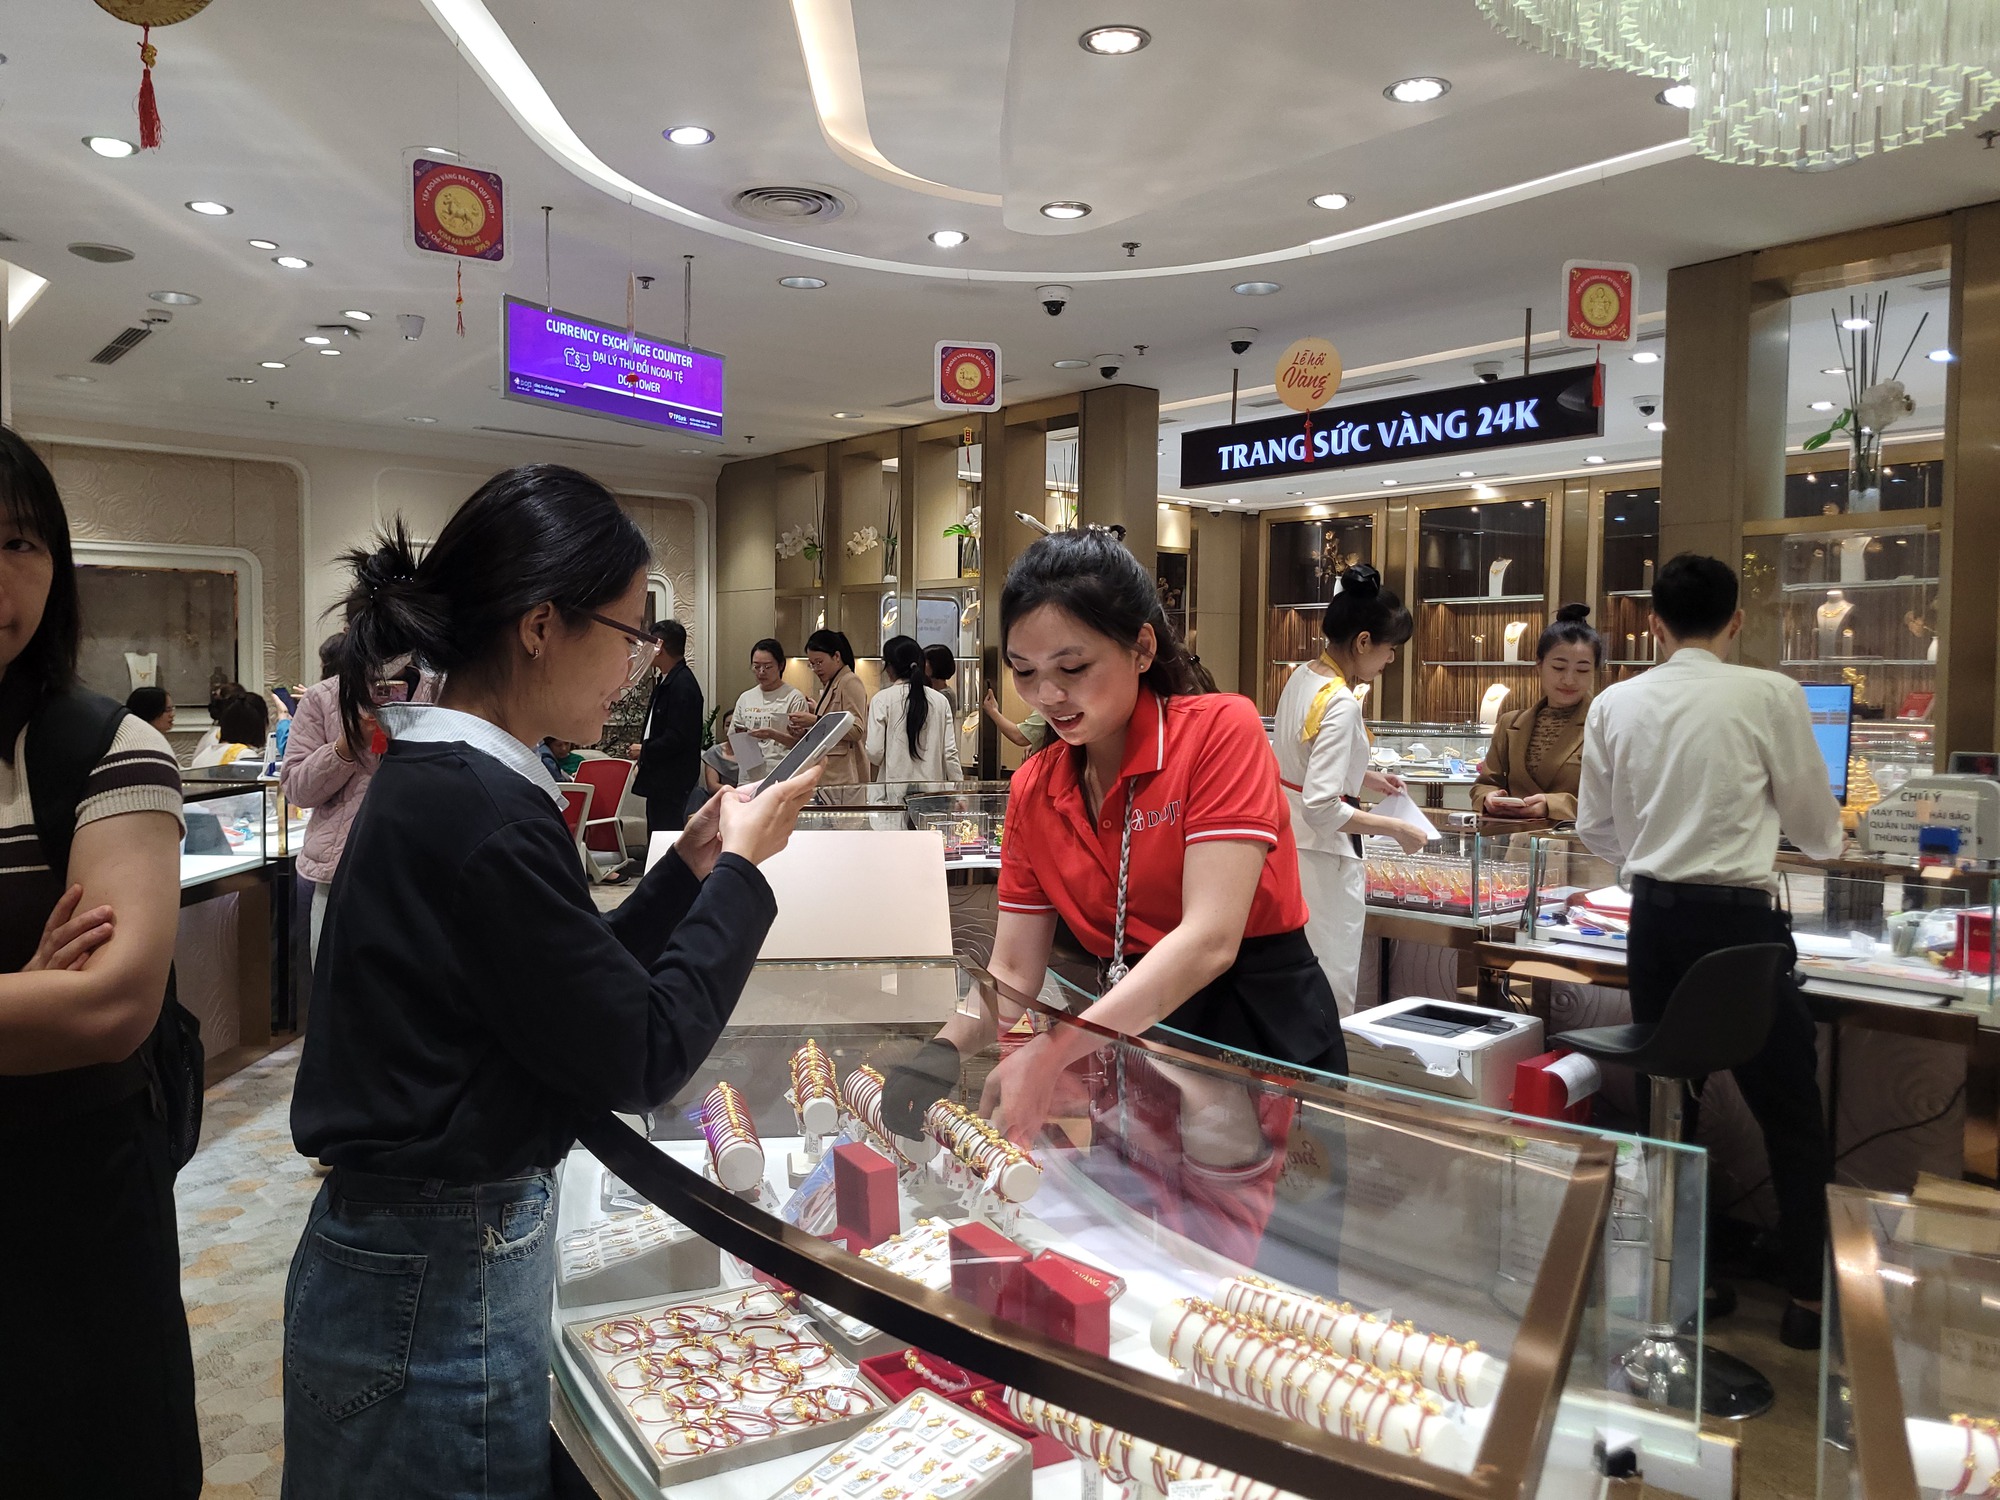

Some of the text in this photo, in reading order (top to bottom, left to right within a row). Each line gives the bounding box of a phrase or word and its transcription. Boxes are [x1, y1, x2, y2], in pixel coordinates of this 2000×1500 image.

[546, 319, 600, 344] CURRENCY
[652, 346, 693, 369] COUNTER
[1307, 352, 1327, 369] hội
[592, 350, 607, 365] ĐẠI
[607, 354, 618, 366] LÝ
[636, 359, 650, 375] ĐỔI
[650, 365, 673, 382] NGOẠI
[673, 370, 684, 385] TỆ
[1282, 366, 1331, 400] Vàng
[1218, 398, 1540, 471] TRANG SỨC VÀNG 24K
